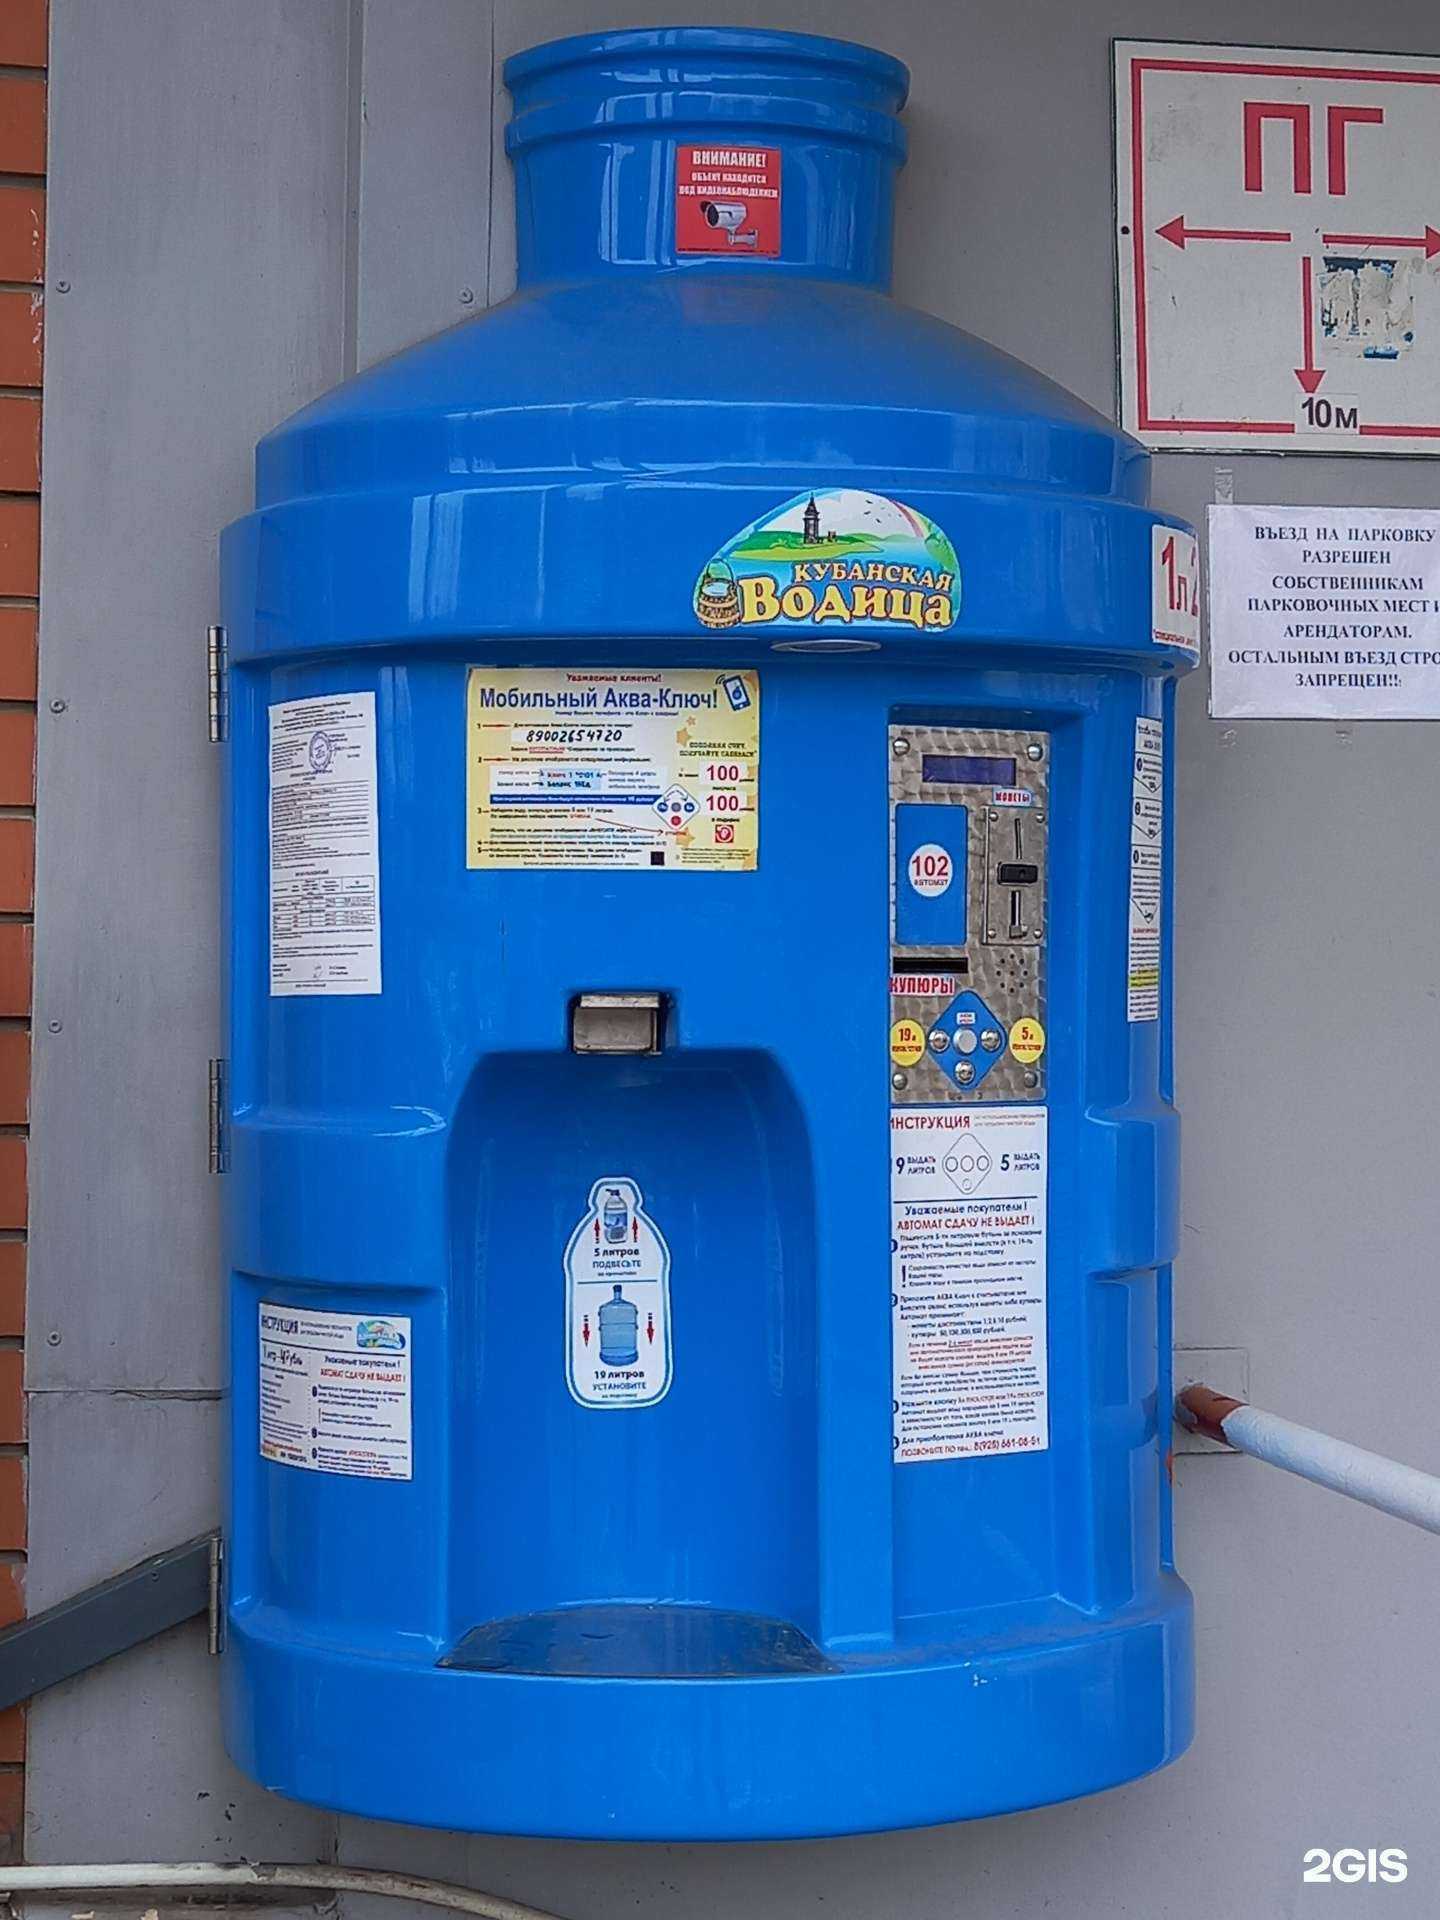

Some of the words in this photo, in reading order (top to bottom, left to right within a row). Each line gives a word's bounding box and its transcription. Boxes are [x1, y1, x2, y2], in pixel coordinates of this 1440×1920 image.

[1244, 101, 1384, 195] ПГ
[692, 150, 767, 168] ВНИМАНИЕ!
[722, 173, 767, 184] НАХОДИТСЯ
[1254, 526, 1308, 542] ВЪЕЗД
[1316, 527, 1339, 541] НА
[1348, 528, 1436, 543] ПАРКОВКУ
[1302, 550, 1391, 564] РАЗРЕШЕН
[794, 561, 954, 592] КУБАНСКАЯ
[1272, 575, 1424, 591] СОБСТВЕННИКАМ
[1247, 598, 1379, 613] ПАРКОВОЧНЫХ
[1383, 599, 1430, 613] МЕСТ
[1283, 624, 1412, 640] АРЕНДАТОРАМ.
[1228, 650, 1339, 665] ОСТАЛЬНЫМ
[1344, 651, 1398, 667] ВЪЕЗД
[567, 673, 618, 683] Уважаемые
[480, 687, 598, 708] Мобильный
[603, 687, 717, 708] Аква-Ключ!
[706, 765, 739, 781] 100
[706, 795, 739, 811] 100
[912, 855, 949, 877] 102
[889, 977, 954, 994] КУПЮРЫ
[907, 1156, 936, 1165] ВЫДАТЬ
[1000, 1154, 1010, 1171] 5
[907, 1166, 936, 1175] ЛИТРОВ
[905, 1205, 964, 1216] Уважаемые
[897, 1219, 942, 1231] АВТОМАТ
[945, 1217, 978, 1230] СДАЧУ
[981, 1217, 993, 1228] НЕ
[594, 1248, 600, 1257] 5
[602, 1248, 640, 1258] литров
[594, 1370, 606, 1380] 19
[608, 1370, 645, 1381] литров
